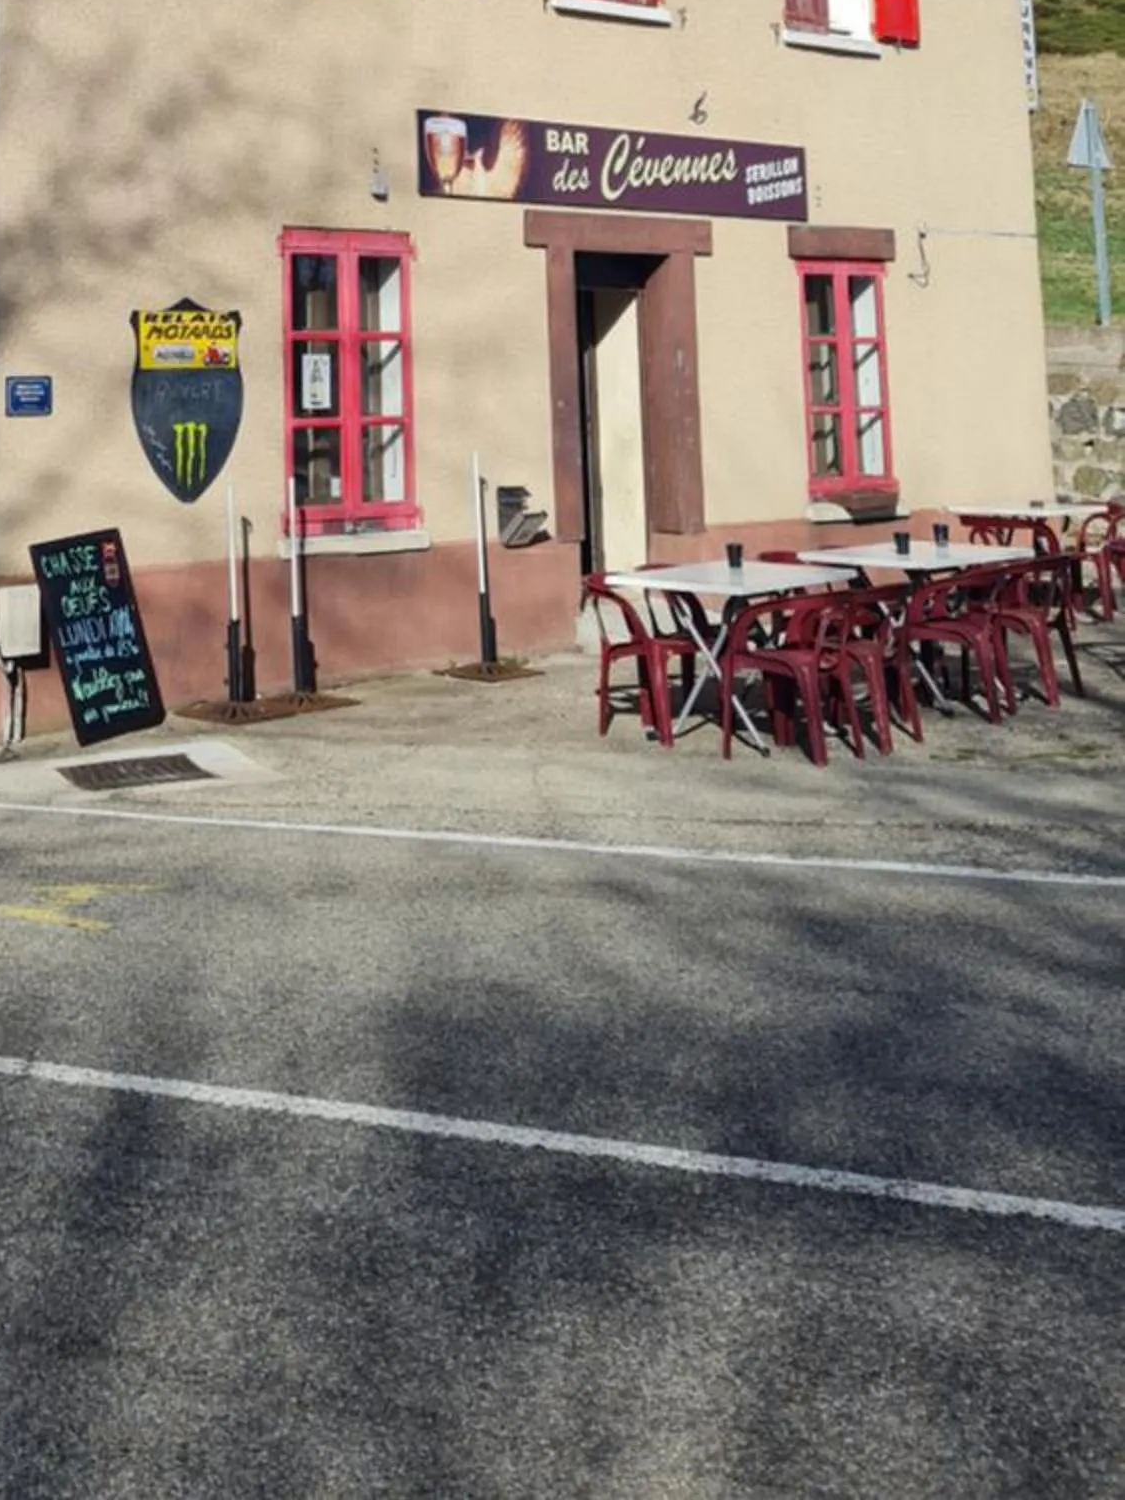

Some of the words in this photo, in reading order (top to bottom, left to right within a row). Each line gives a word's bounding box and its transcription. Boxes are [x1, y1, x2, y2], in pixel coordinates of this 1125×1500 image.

[545, 128, 590, 155] BAR
[552, 158, 590, 193] des
[600, 132, 739, 201] Cévennes
[144, 312, 230, 324] RELAIS
[146, 324, 234, 340] MOTARDS
[40, 545, 99, 579] CHASSE
